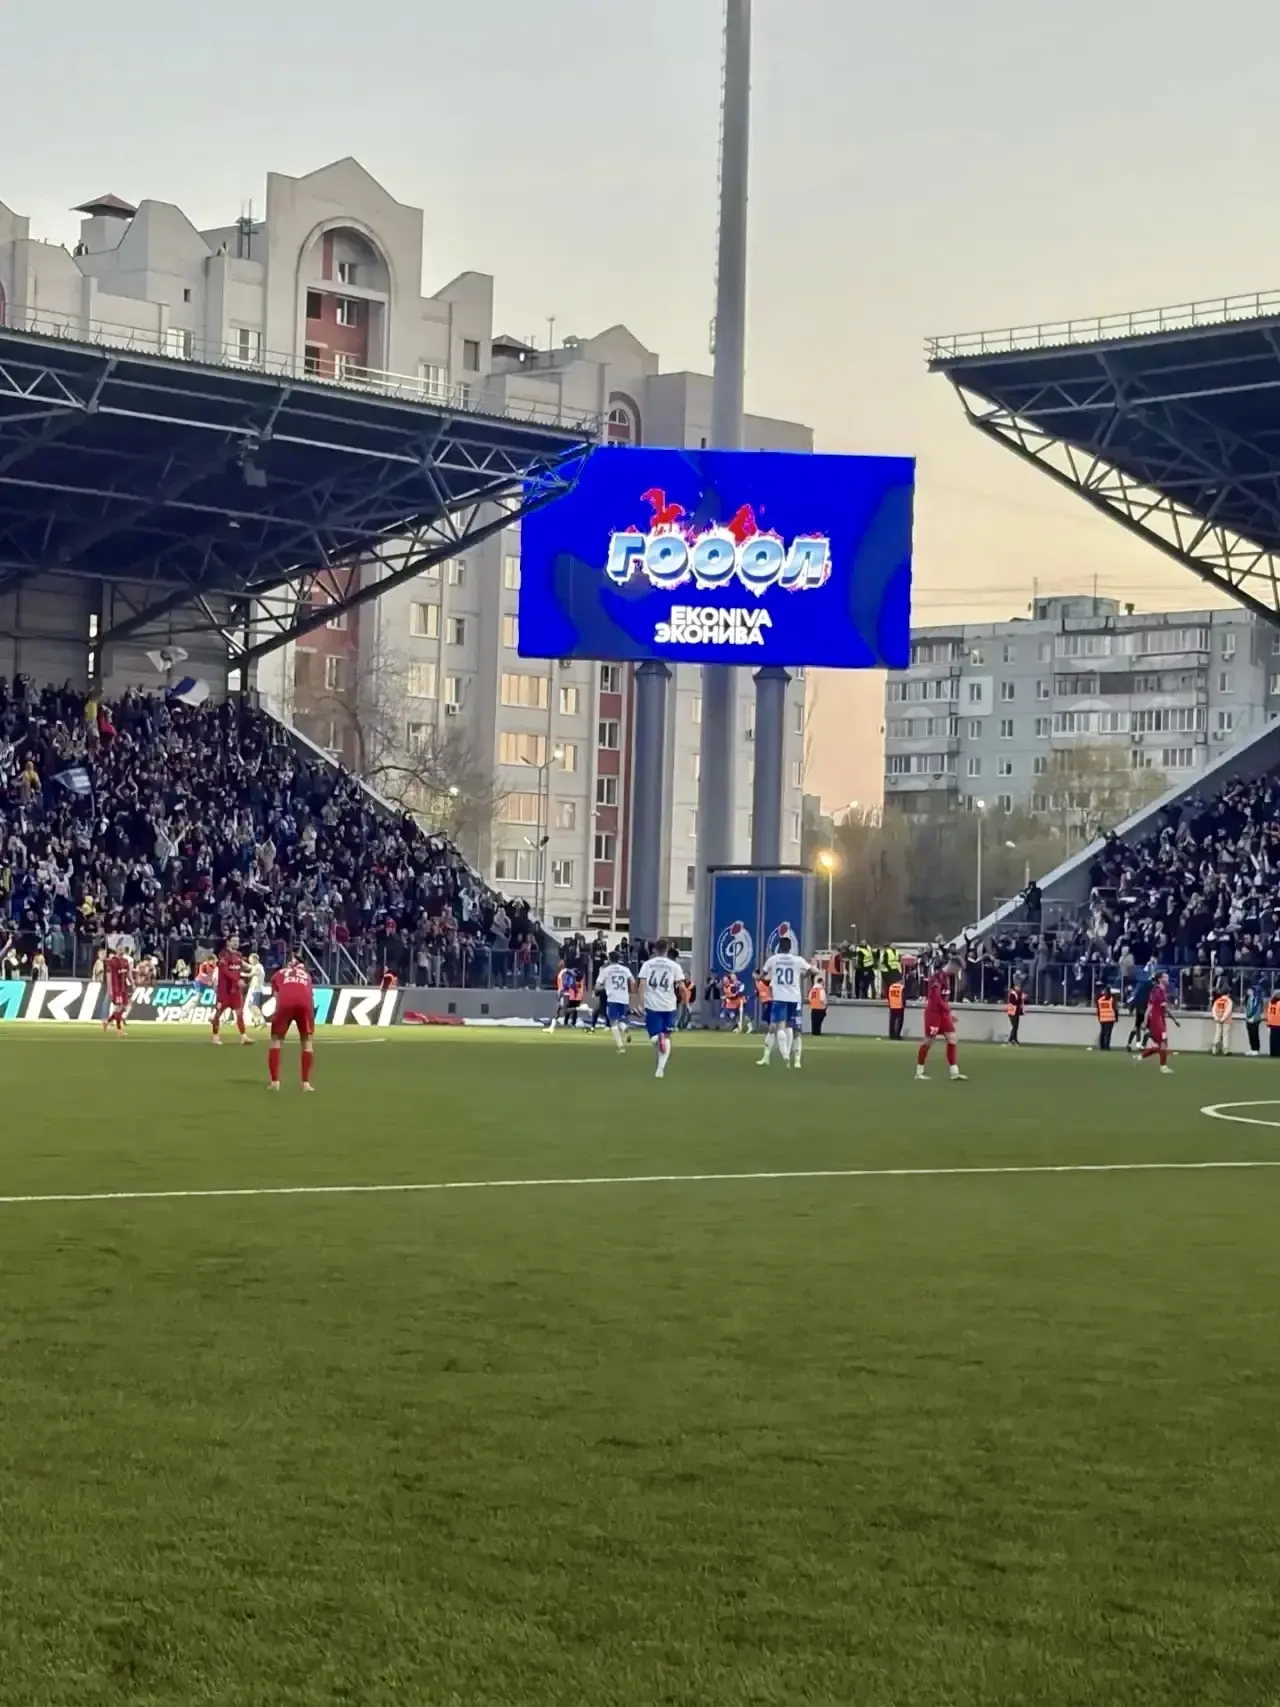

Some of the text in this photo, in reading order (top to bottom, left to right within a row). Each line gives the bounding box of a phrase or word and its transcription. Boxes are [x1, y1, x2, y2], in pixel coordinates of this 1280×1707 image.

[606, 531, 831, 590] ГОООЛ
[670, 605, 773, 628] EKONIVA
[654, 622, 765, 645] ЭКОНИВА
[611, 975, 626, 990] 52
[648, 970, 669, 992] 44
[776, 967, 794, 985] 20
